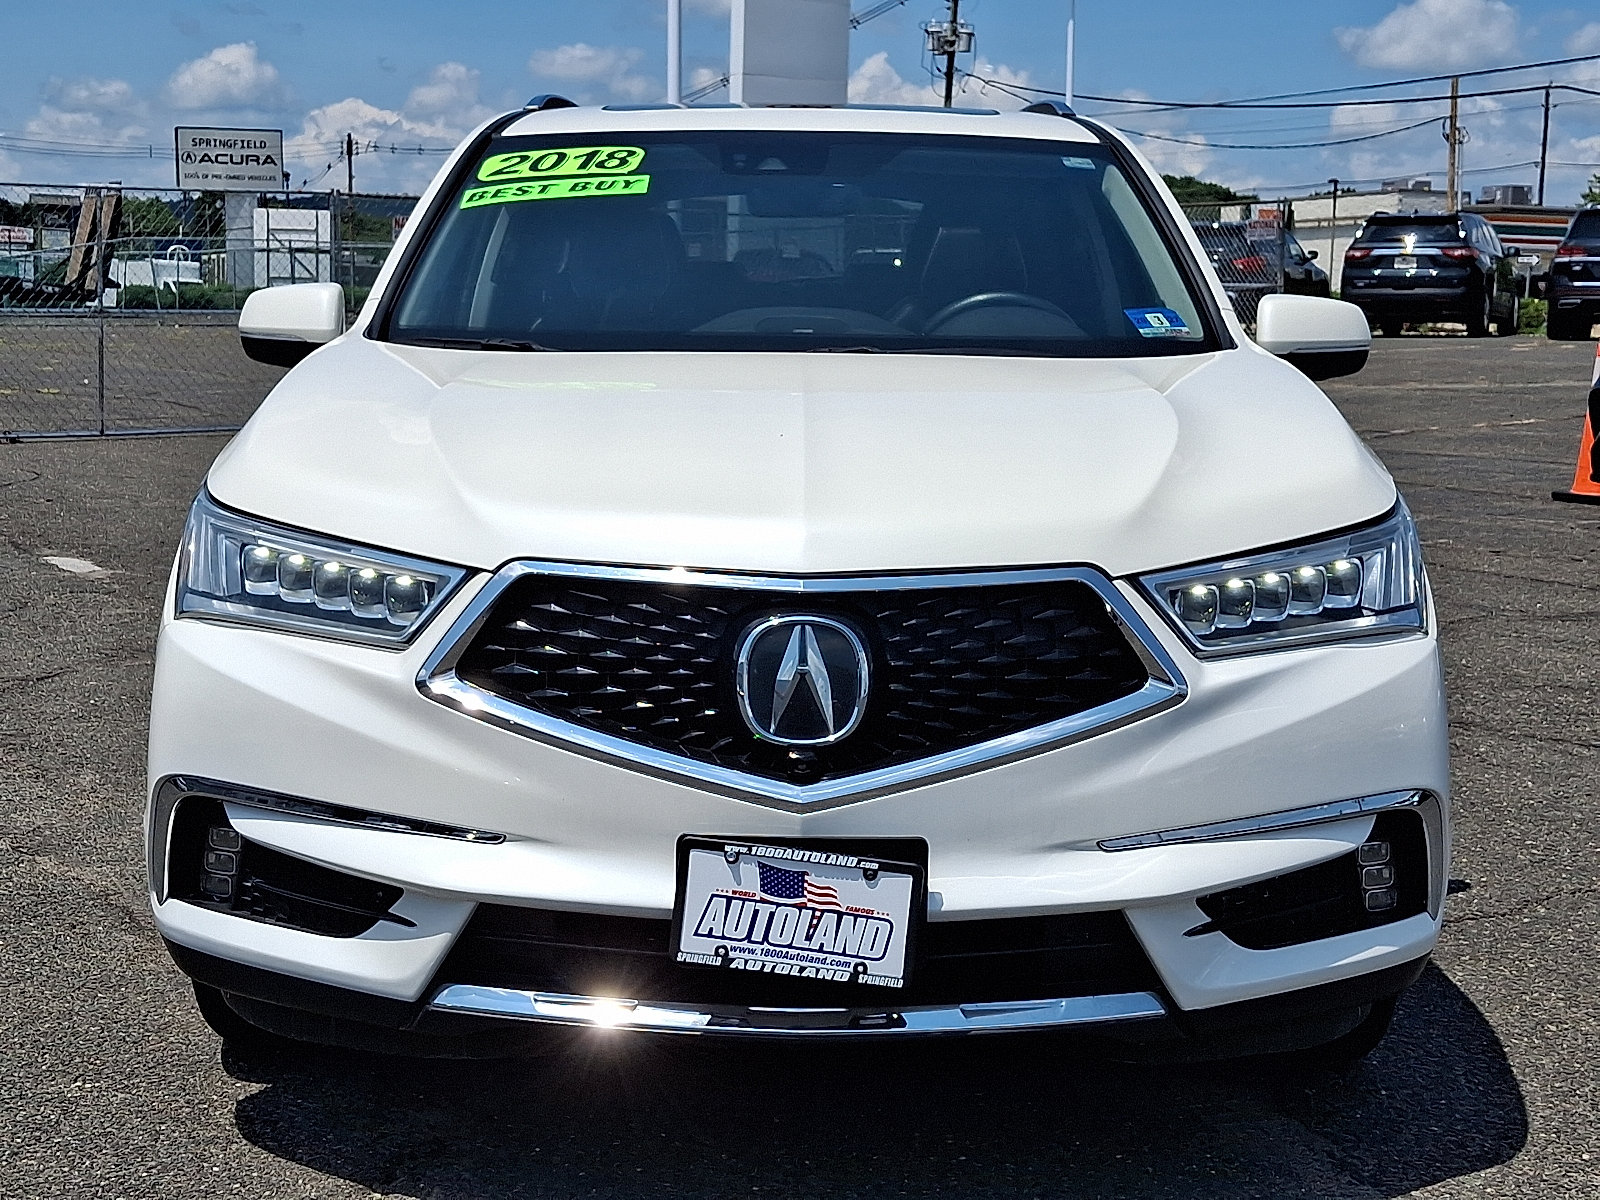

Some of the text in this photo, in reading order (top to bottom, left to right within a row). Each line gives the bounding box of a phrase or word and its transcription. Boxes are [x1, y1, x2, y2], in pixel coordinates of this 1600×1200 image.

[191, 137, 267, 150] SPRINGFIELD
[198, 152, 278, 166] ACURA
[485, 149, 640, 178] 2018
[465, 179, 644, 203] BEST BUY
[1153, 315, 1164, 326] 3
[724, 845, 879, 869] www.1800AUTOLAND.com
[731, 889, 875, 915] WORLD FAMOUS
[697, 896, 891, 959] AUTOLAND
[677, 952, 722, 966] SPRINGFIELD
[729, 945, 852, 969] www.1800Autoland.com
[729, 958, 851, 981] AUTOLAND
[858, 973, 903, 988] SPRINGFIELD
